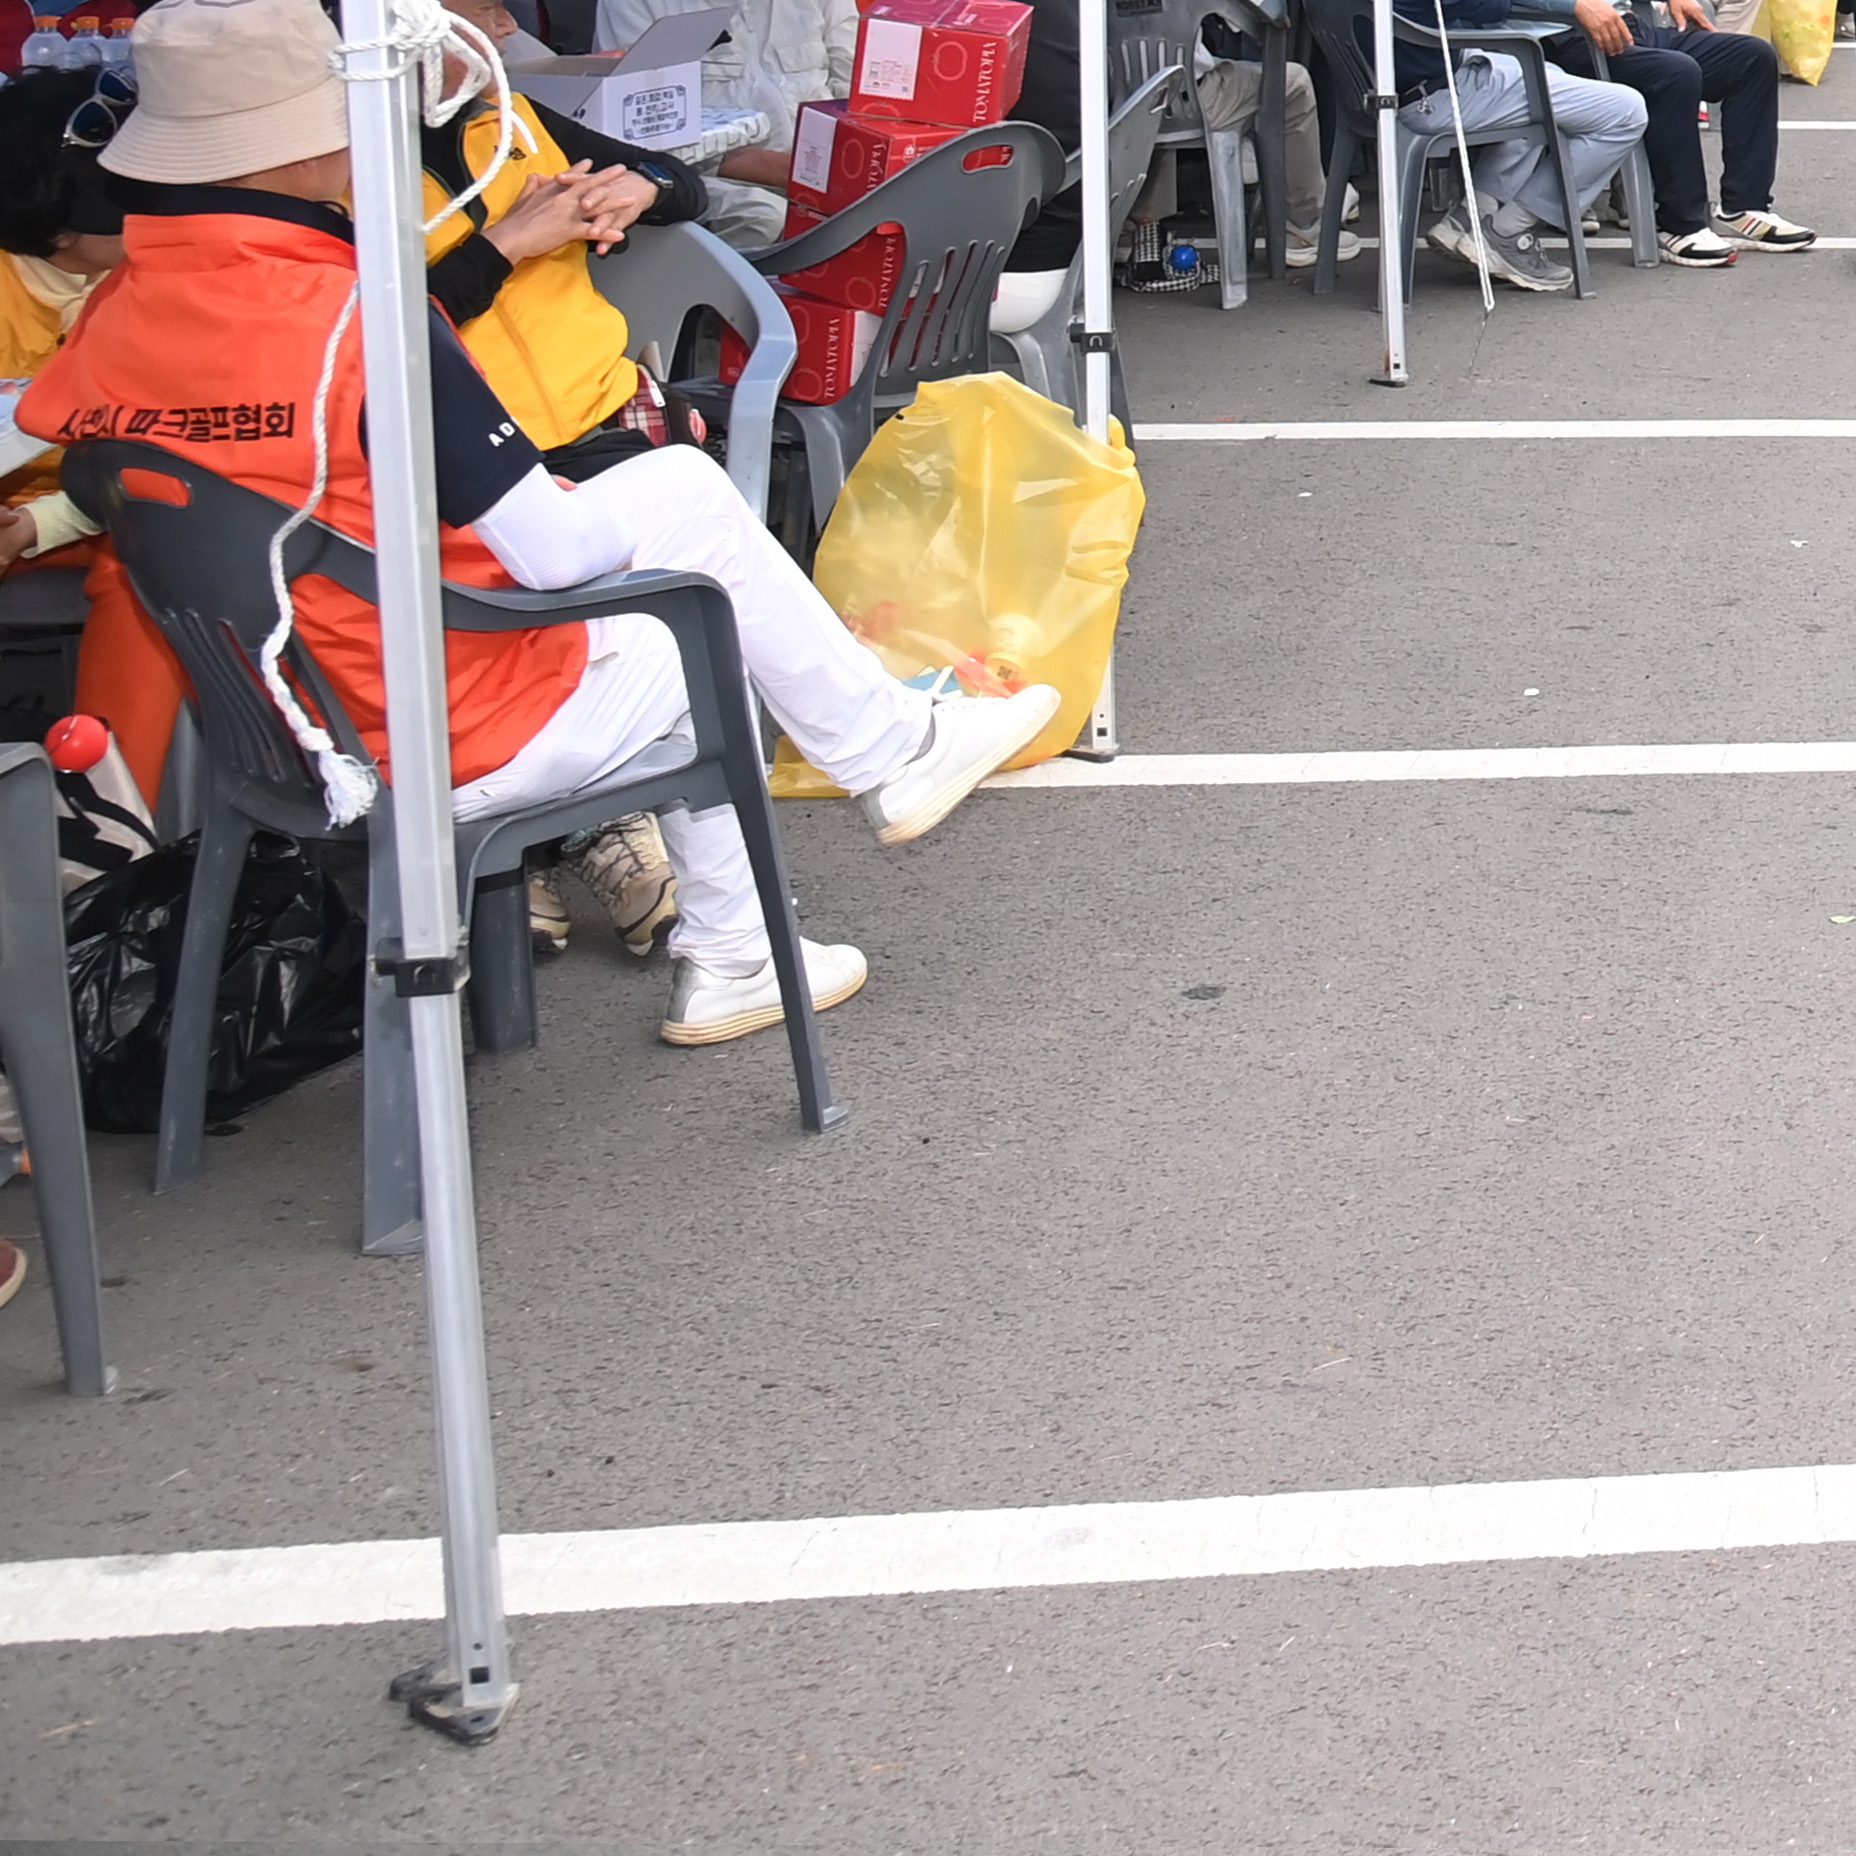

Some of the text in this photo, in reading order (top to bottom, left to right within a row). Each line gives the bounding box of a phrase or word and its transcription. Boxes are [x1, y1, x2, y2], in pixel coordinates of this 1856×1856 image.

[973, 41, 996, 122] TOMATOPIA
[878, 237, 897, 308] TOMATOPI
[824, 318, 840, 399] TOMATOPIA
